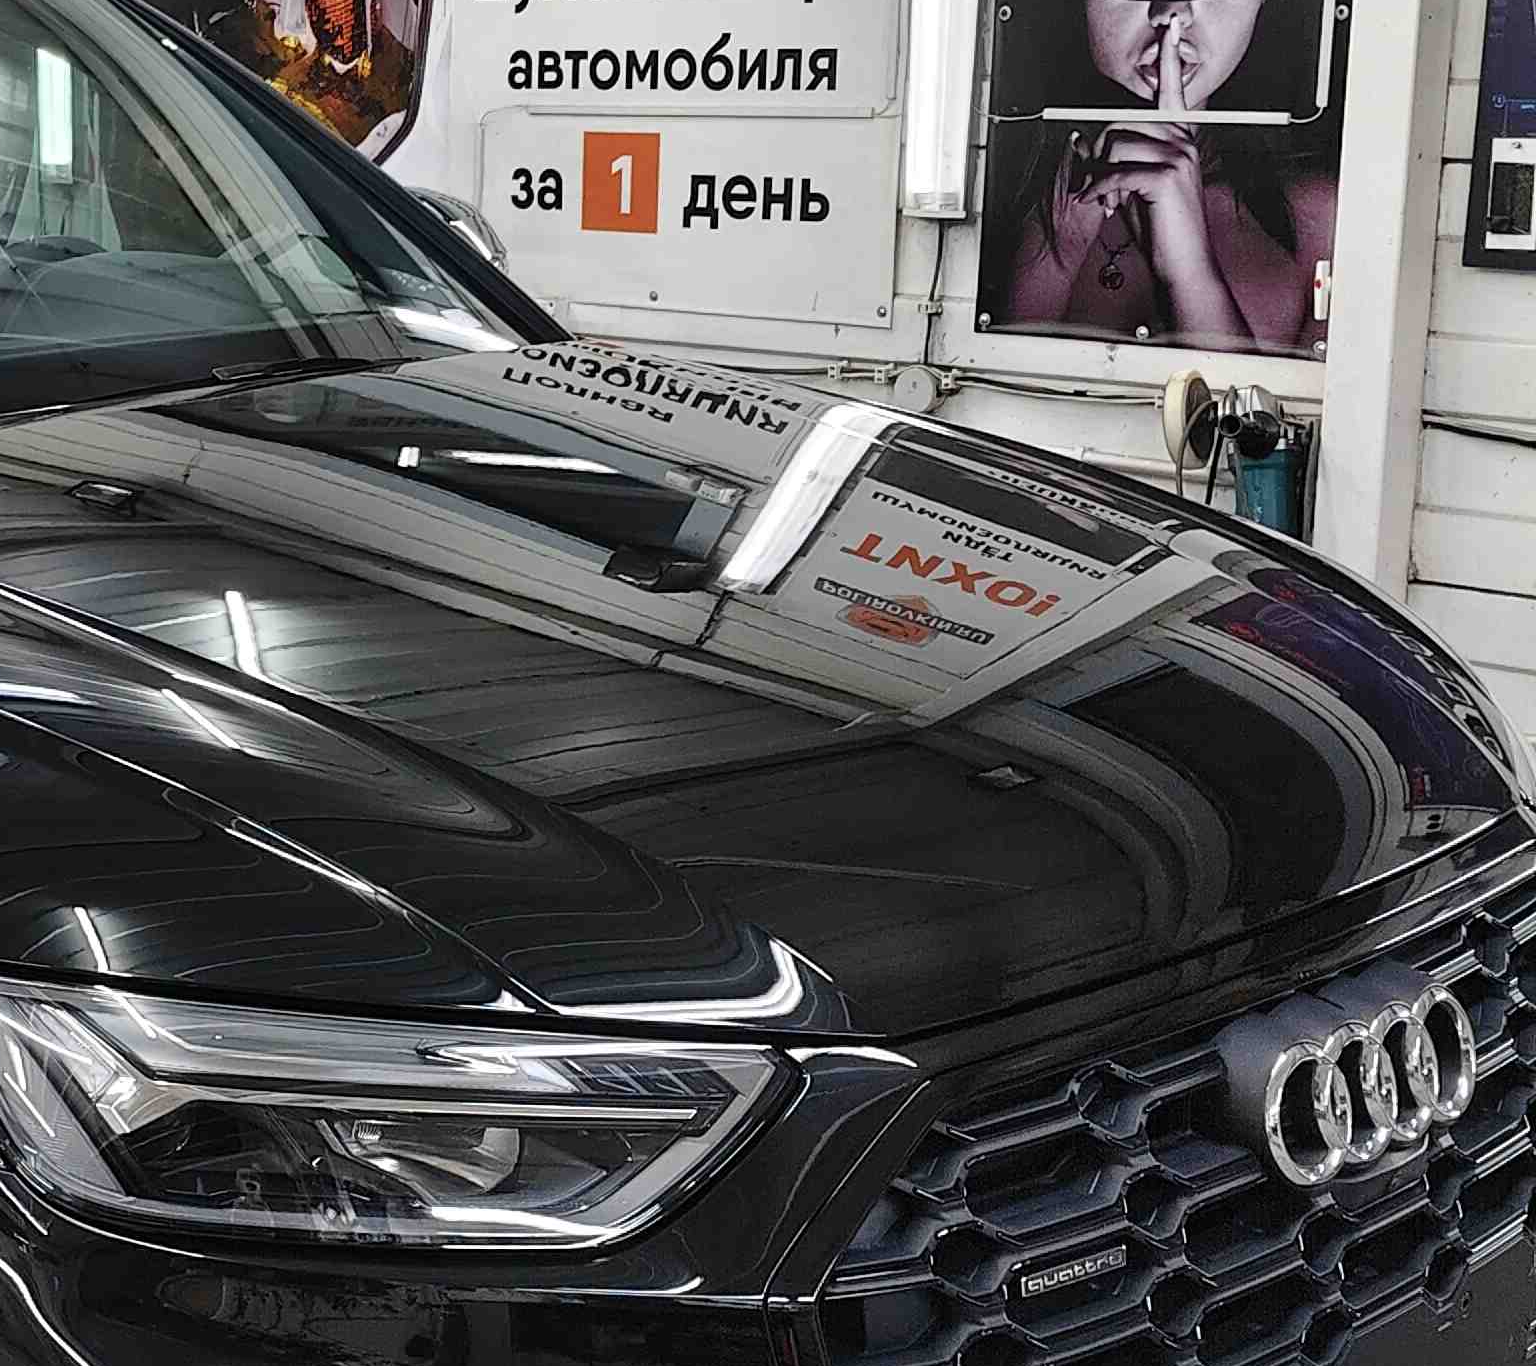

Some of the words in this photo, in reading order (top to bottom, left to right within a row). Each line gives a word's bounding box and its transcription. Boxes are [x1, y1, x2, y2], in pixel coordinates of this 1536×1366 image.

[507, 33, 839, 90] автомобиля
[510, 165, 563, 210] за
[610, 154, 635, 215] 1
[682, 172, 831, 229] день
[1027, 1251, 1123, 1293] quattro
